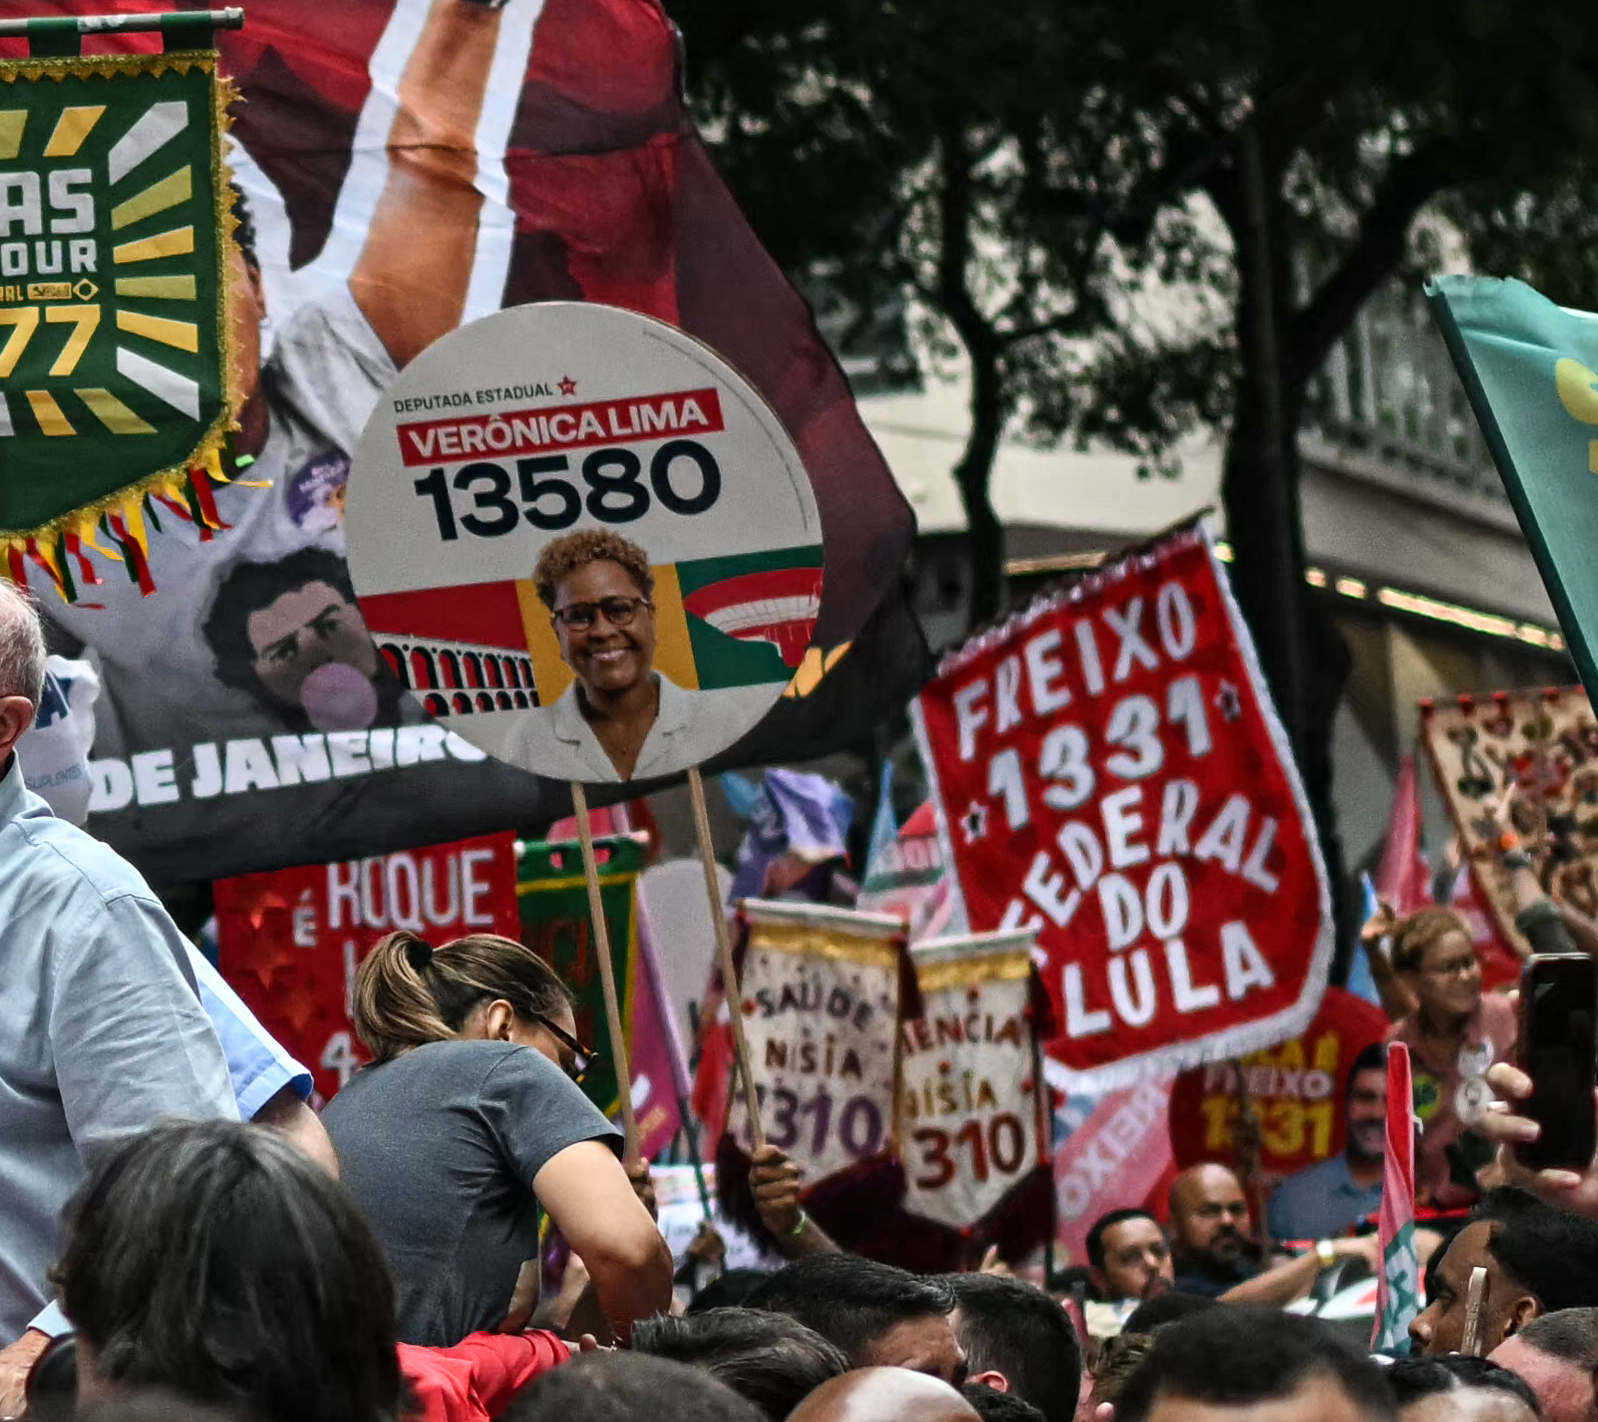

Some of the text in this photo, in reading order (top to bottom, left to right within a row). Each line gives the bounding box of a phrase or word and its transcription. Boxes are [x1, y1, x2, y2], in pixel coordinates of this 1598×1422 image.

[393, 390, 473, 414] DEPUTADA
[475, 382, 554, 405] ESTADUAL
[408, 397, 710, 460] VERÔNICA LIMA
[413, 438, 722, 542] 13580
[952, 581, 1197, 762] FREIXO
[89, 751, 186, 813] DE
[987, 675, 1212, 831] 1331
[1098, 860, 1190, 953] DO
[1062, 920, 1274, 1039] LULA
[912, 1111, 1026, 1190] 310
[1201, 1095, 1335, 1159] 131
